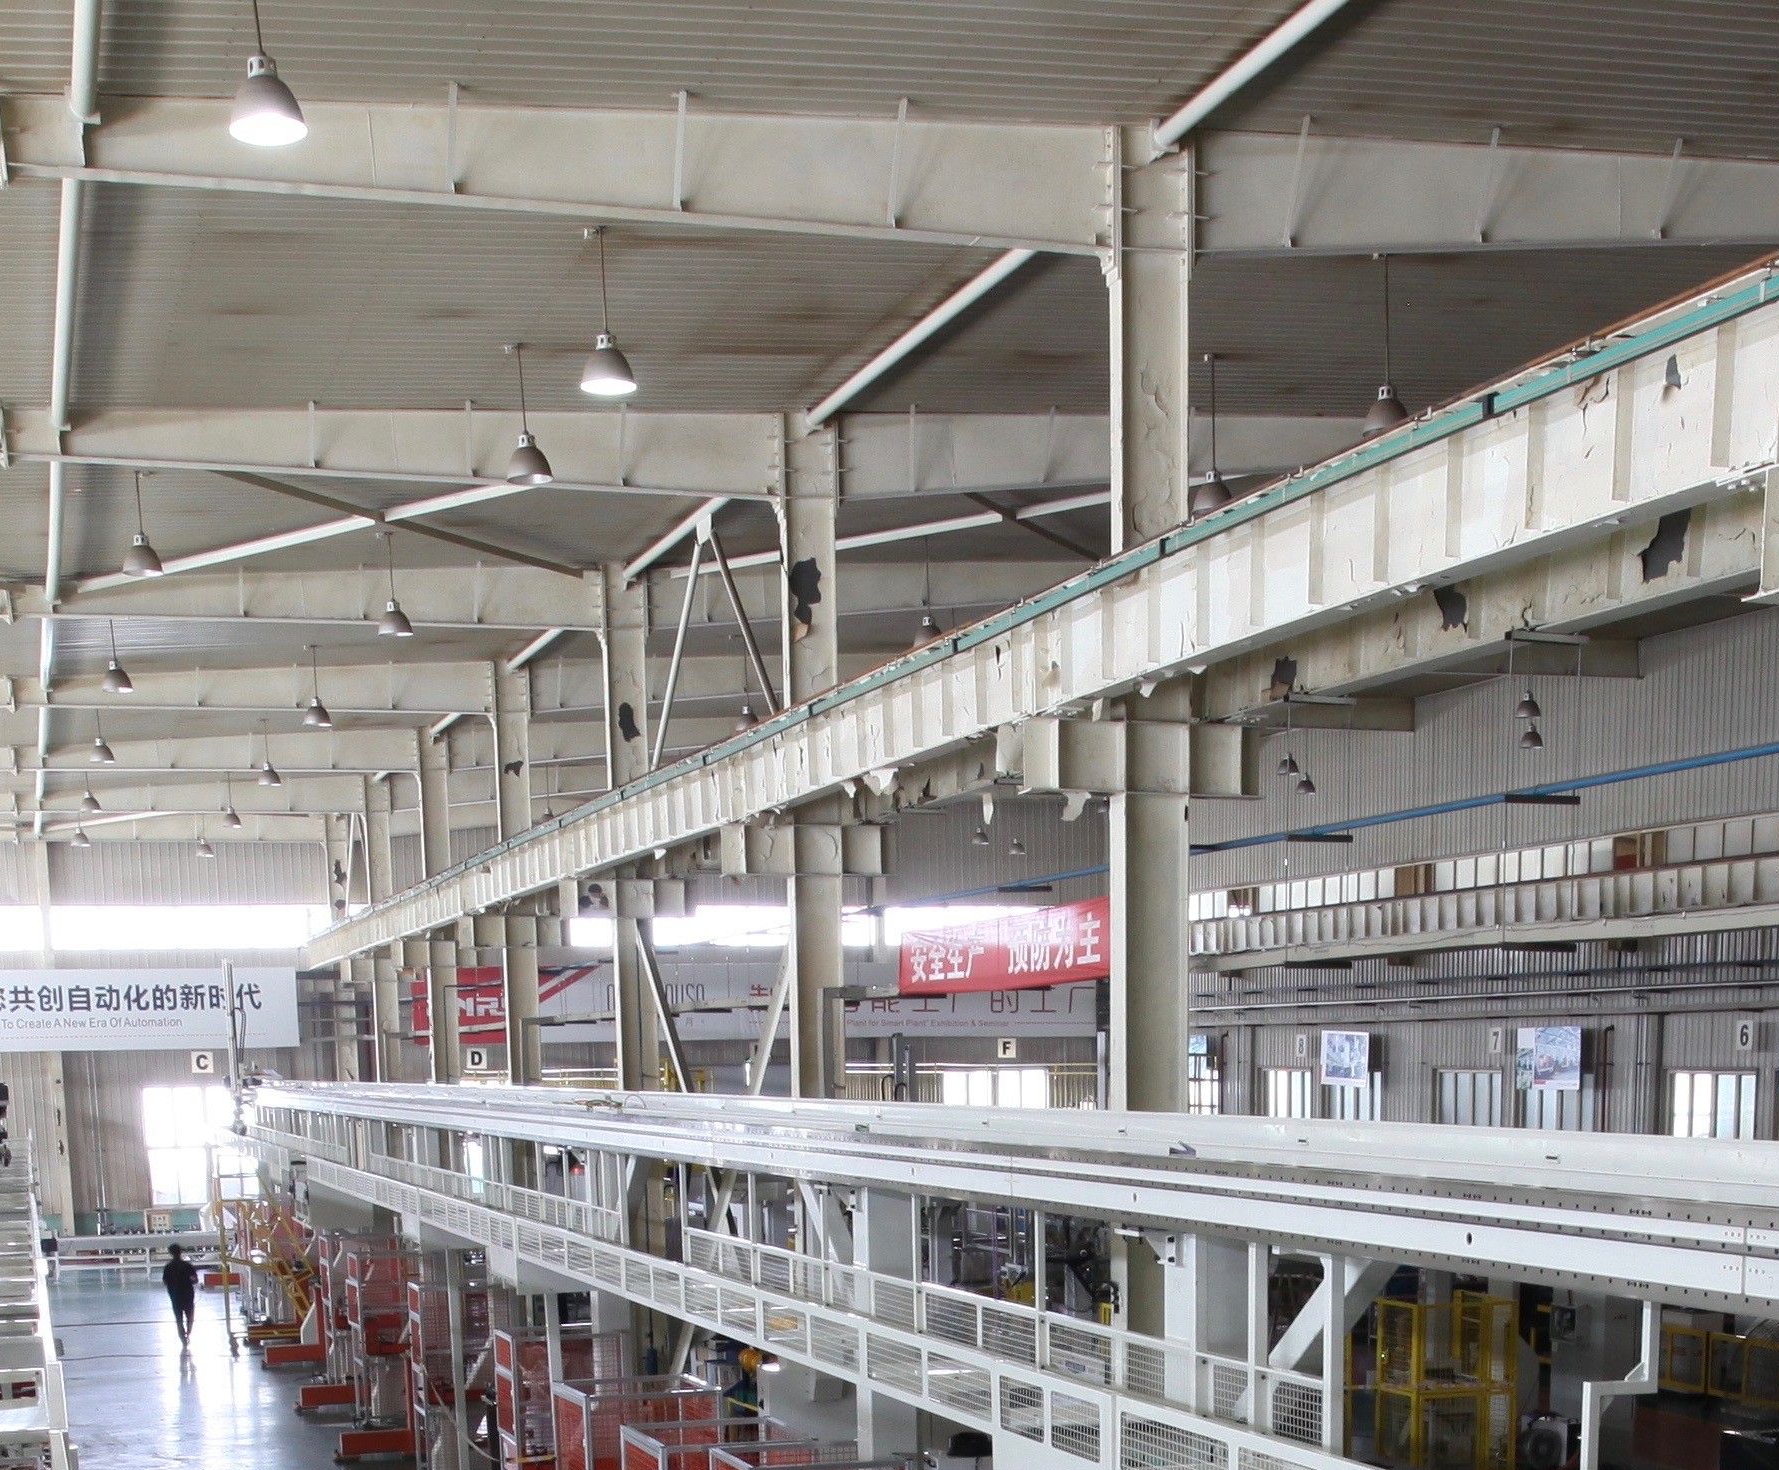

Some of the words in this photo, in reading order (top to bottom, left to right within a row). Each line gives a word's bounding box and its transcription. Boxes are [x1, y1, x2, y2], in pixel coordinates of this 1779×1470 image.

[911, 934, 985, 983] 安全生产
[1007, 912, 1102, 975] 预防为主
[16, 1018, 52, 1029] Create
[63, 1018, 87, 1028] New
[89, 1017, 107, 1028] Era
[124, 1016, 183, 1028] Automation
[1492, 1031, 1499, 1050] 7
[1740, 1025, 1749, 1046] 6
[1003, 1041, 1011, 1055] F
[196, 1055, 209, 1070] C
[471, 1051, 482, 1066] D
